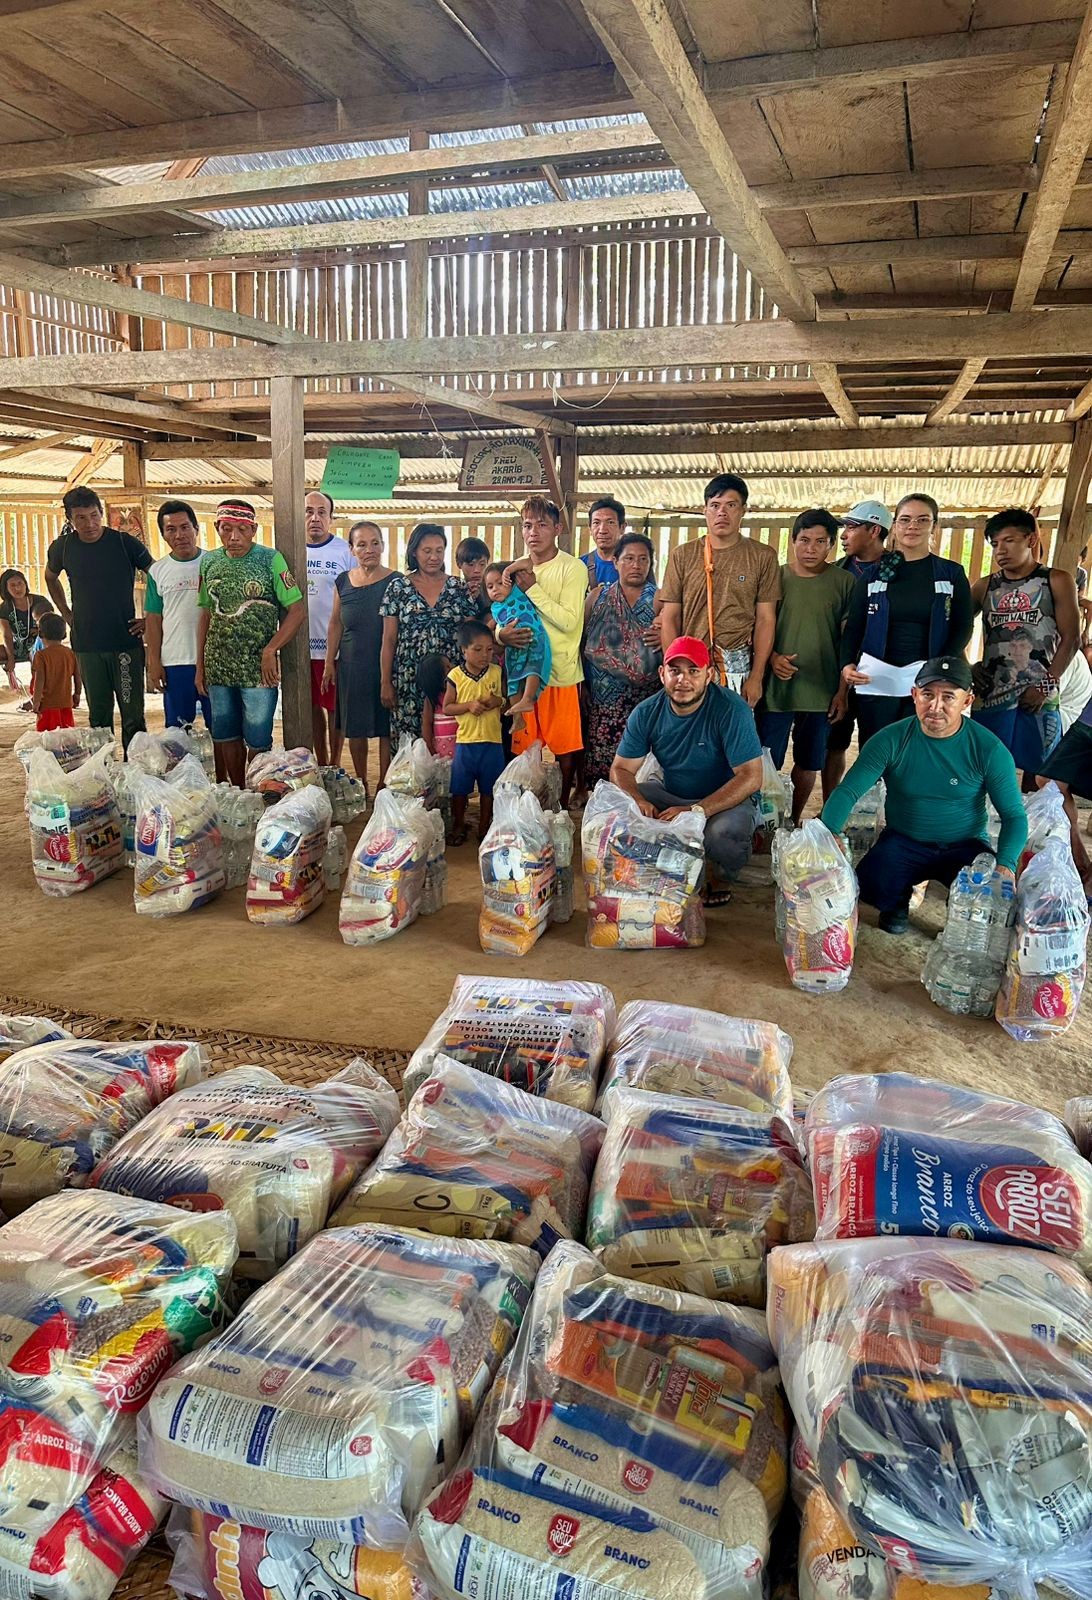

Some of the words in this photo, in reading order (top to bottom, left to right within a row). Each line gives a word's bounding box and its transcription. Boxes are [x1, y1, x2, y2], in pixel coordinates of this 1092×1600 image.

[325, 561, 338, 569] SE
[1010, 611, 1038, 624] WALTER
[489, 1021, 531, 1029] COMBATE
[848, 1161, 857, 1194] ARROZ
[968, 1167, 983, 1185] arroz
[891, 1182, 899, 1200] longo
[911, 1147, 941, 1236] Branco
[943, 1172, 953, 1208] ARROZ
[966, 1184, 974, 1195] do
[966, 1195, 978, 1212] seu
[995, 1169, 1041, 1236] ARROZ
[1040, 1181, 1073, 1229] SEU
[848, 1195, 857, 1237] BRANCO
[105, 1343, 169, 1411] Reserva
[34, 1434, 65, 1450] ARROZ
[552, 1435, 599, 1463] BRANCO
[630, 1464, 647, 1476] SEU
[623, 1473, 649, 1490] ARROZ
[477, 1498, 521, 1525] BRANCO
[124, 1512, 142, 1536] ARROZ
[554, 1518, 574, 1534] SEU
[549, 1529, 574, 1554] ARROZ
[826, 1545, 877, 1564] VENDA
